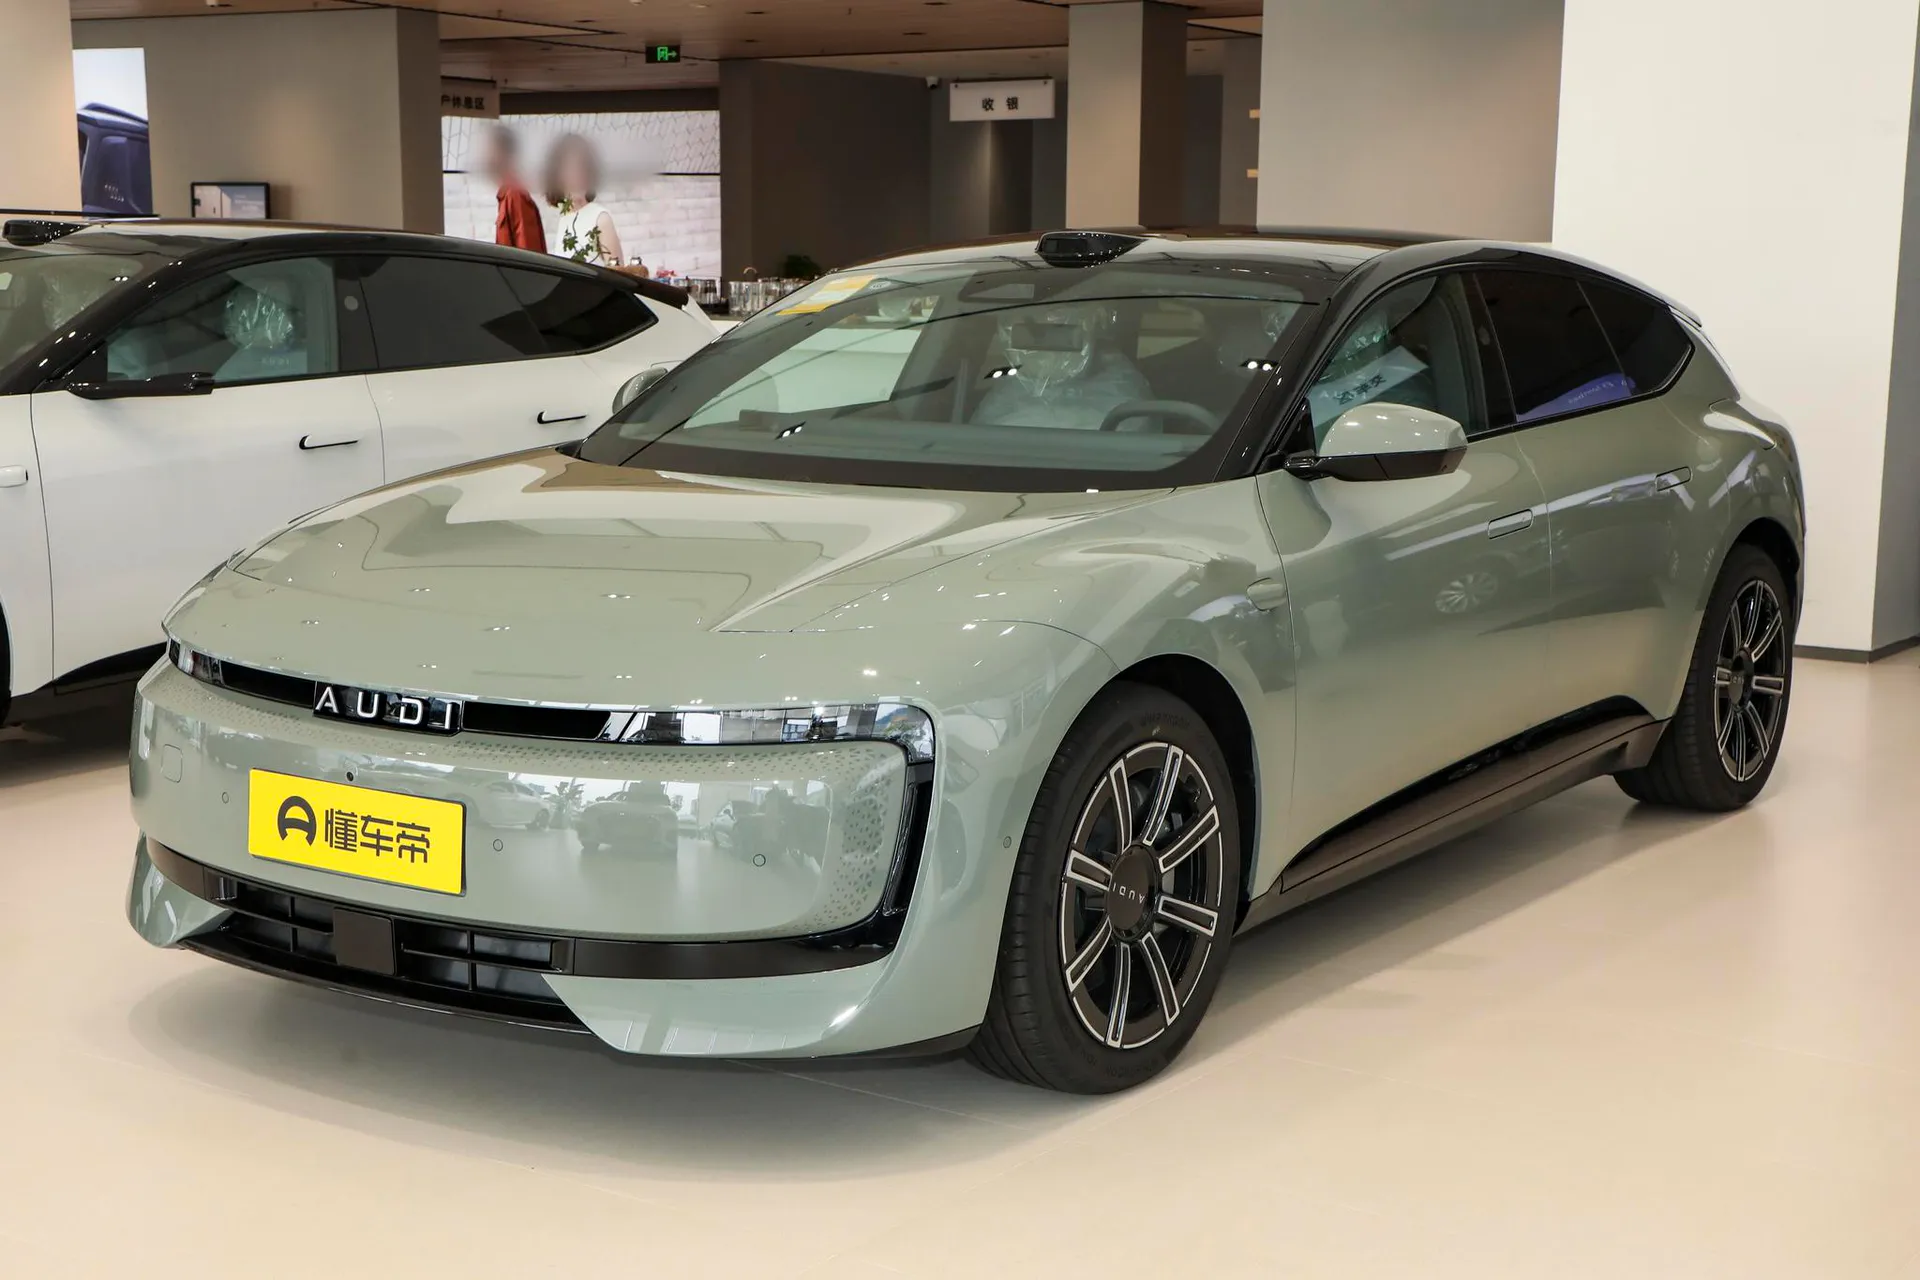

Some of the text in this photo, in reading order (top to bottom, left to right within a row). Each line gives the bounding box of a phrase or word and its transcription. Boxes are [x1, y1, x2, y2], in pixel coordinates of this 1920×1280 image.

[982, 97, 1019, 111] 收银
[315, 686, 452, 729] AUDI
[325, 808, 430, 863] 懂车帝
[1113, 881, 1145, 904] AUDI
